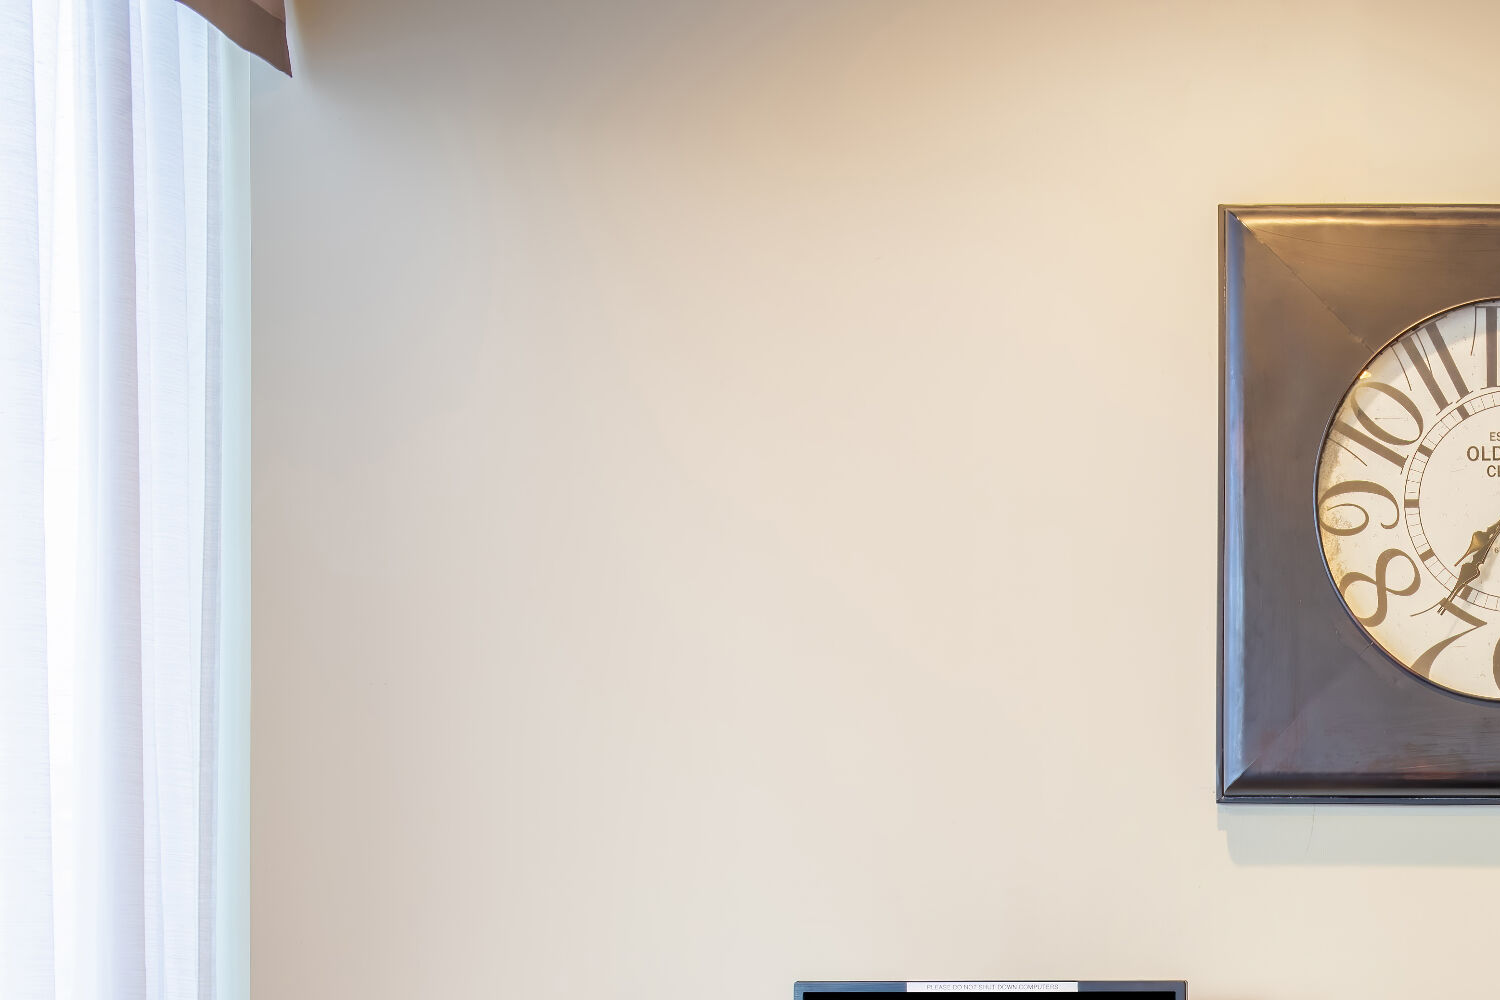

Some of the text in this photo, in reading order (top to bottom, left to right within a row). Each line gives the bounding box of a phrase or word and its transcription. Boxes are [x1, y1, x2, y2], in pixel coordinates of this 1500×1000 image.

[1326, 381, 1424, 474] 10
[1320, 480, 1400, 537] 9
[1339, 549, 1422, 628] 8
[1411, 598, 1487, 679] 7
